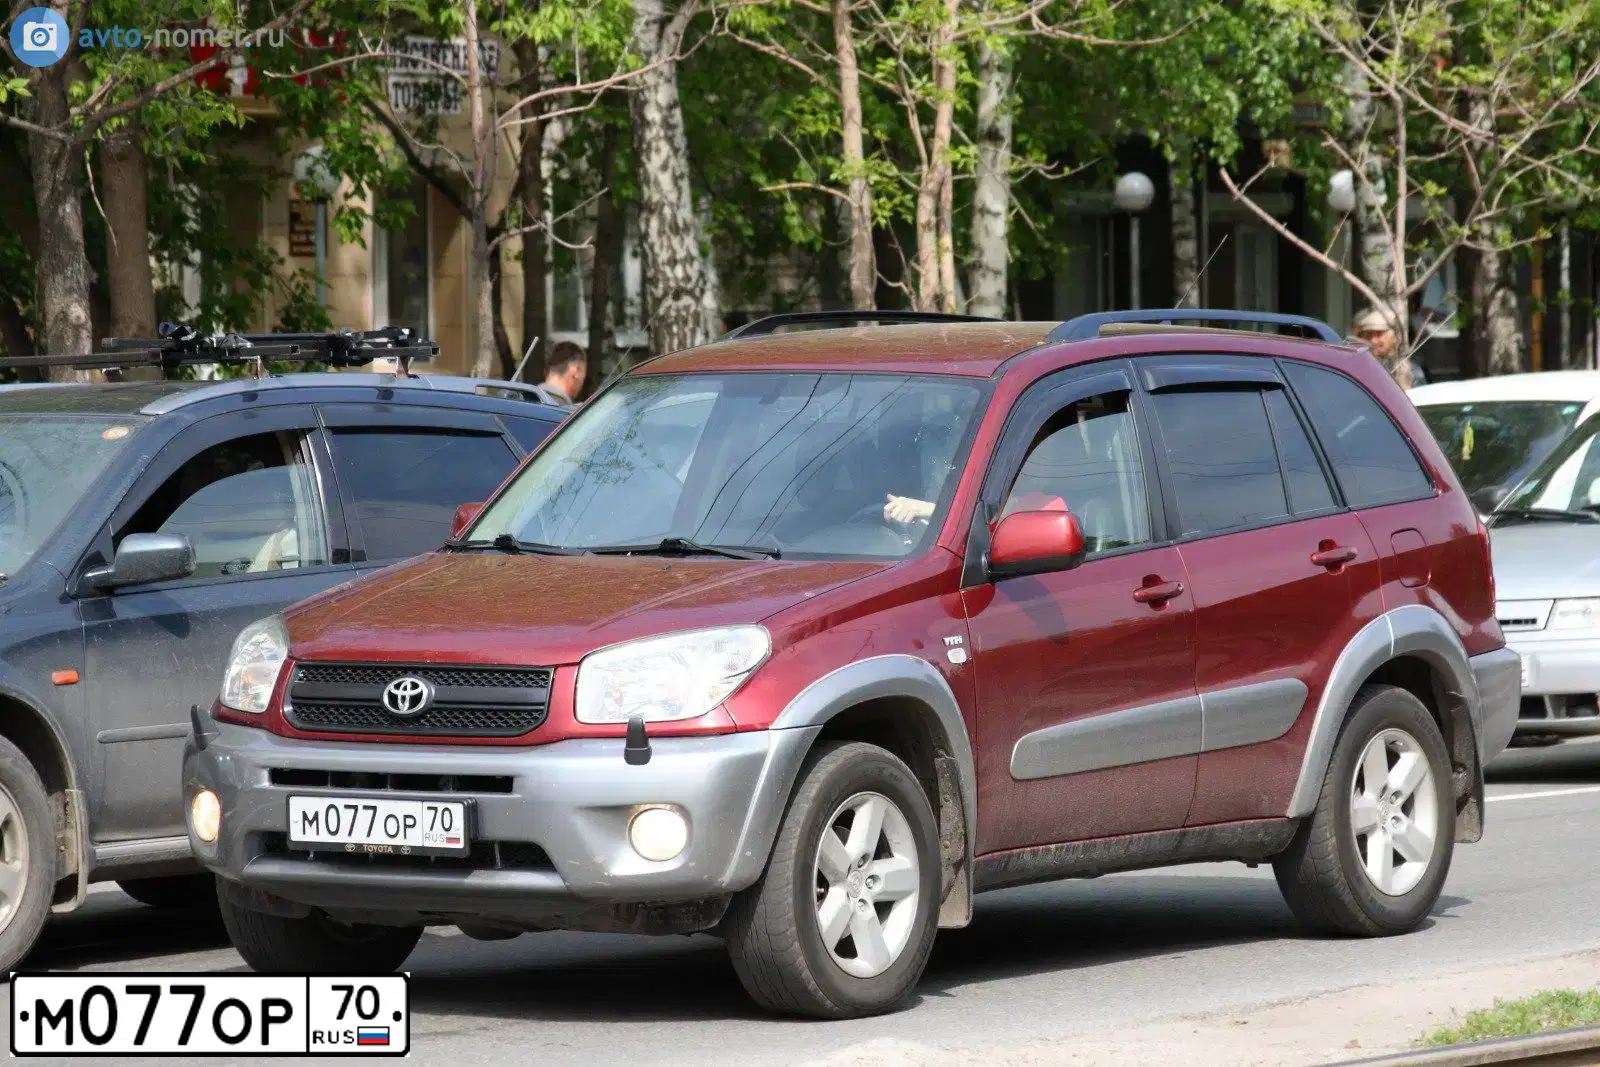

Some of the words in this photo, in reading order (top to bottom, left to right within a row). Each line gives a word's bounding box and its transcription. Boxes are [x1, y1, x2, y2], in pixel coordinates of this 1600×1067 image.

[427, 806, 453, 832] 70
[424, 833, 444, 843] RUS
[362, 843, 394, 854] TOYOTA
